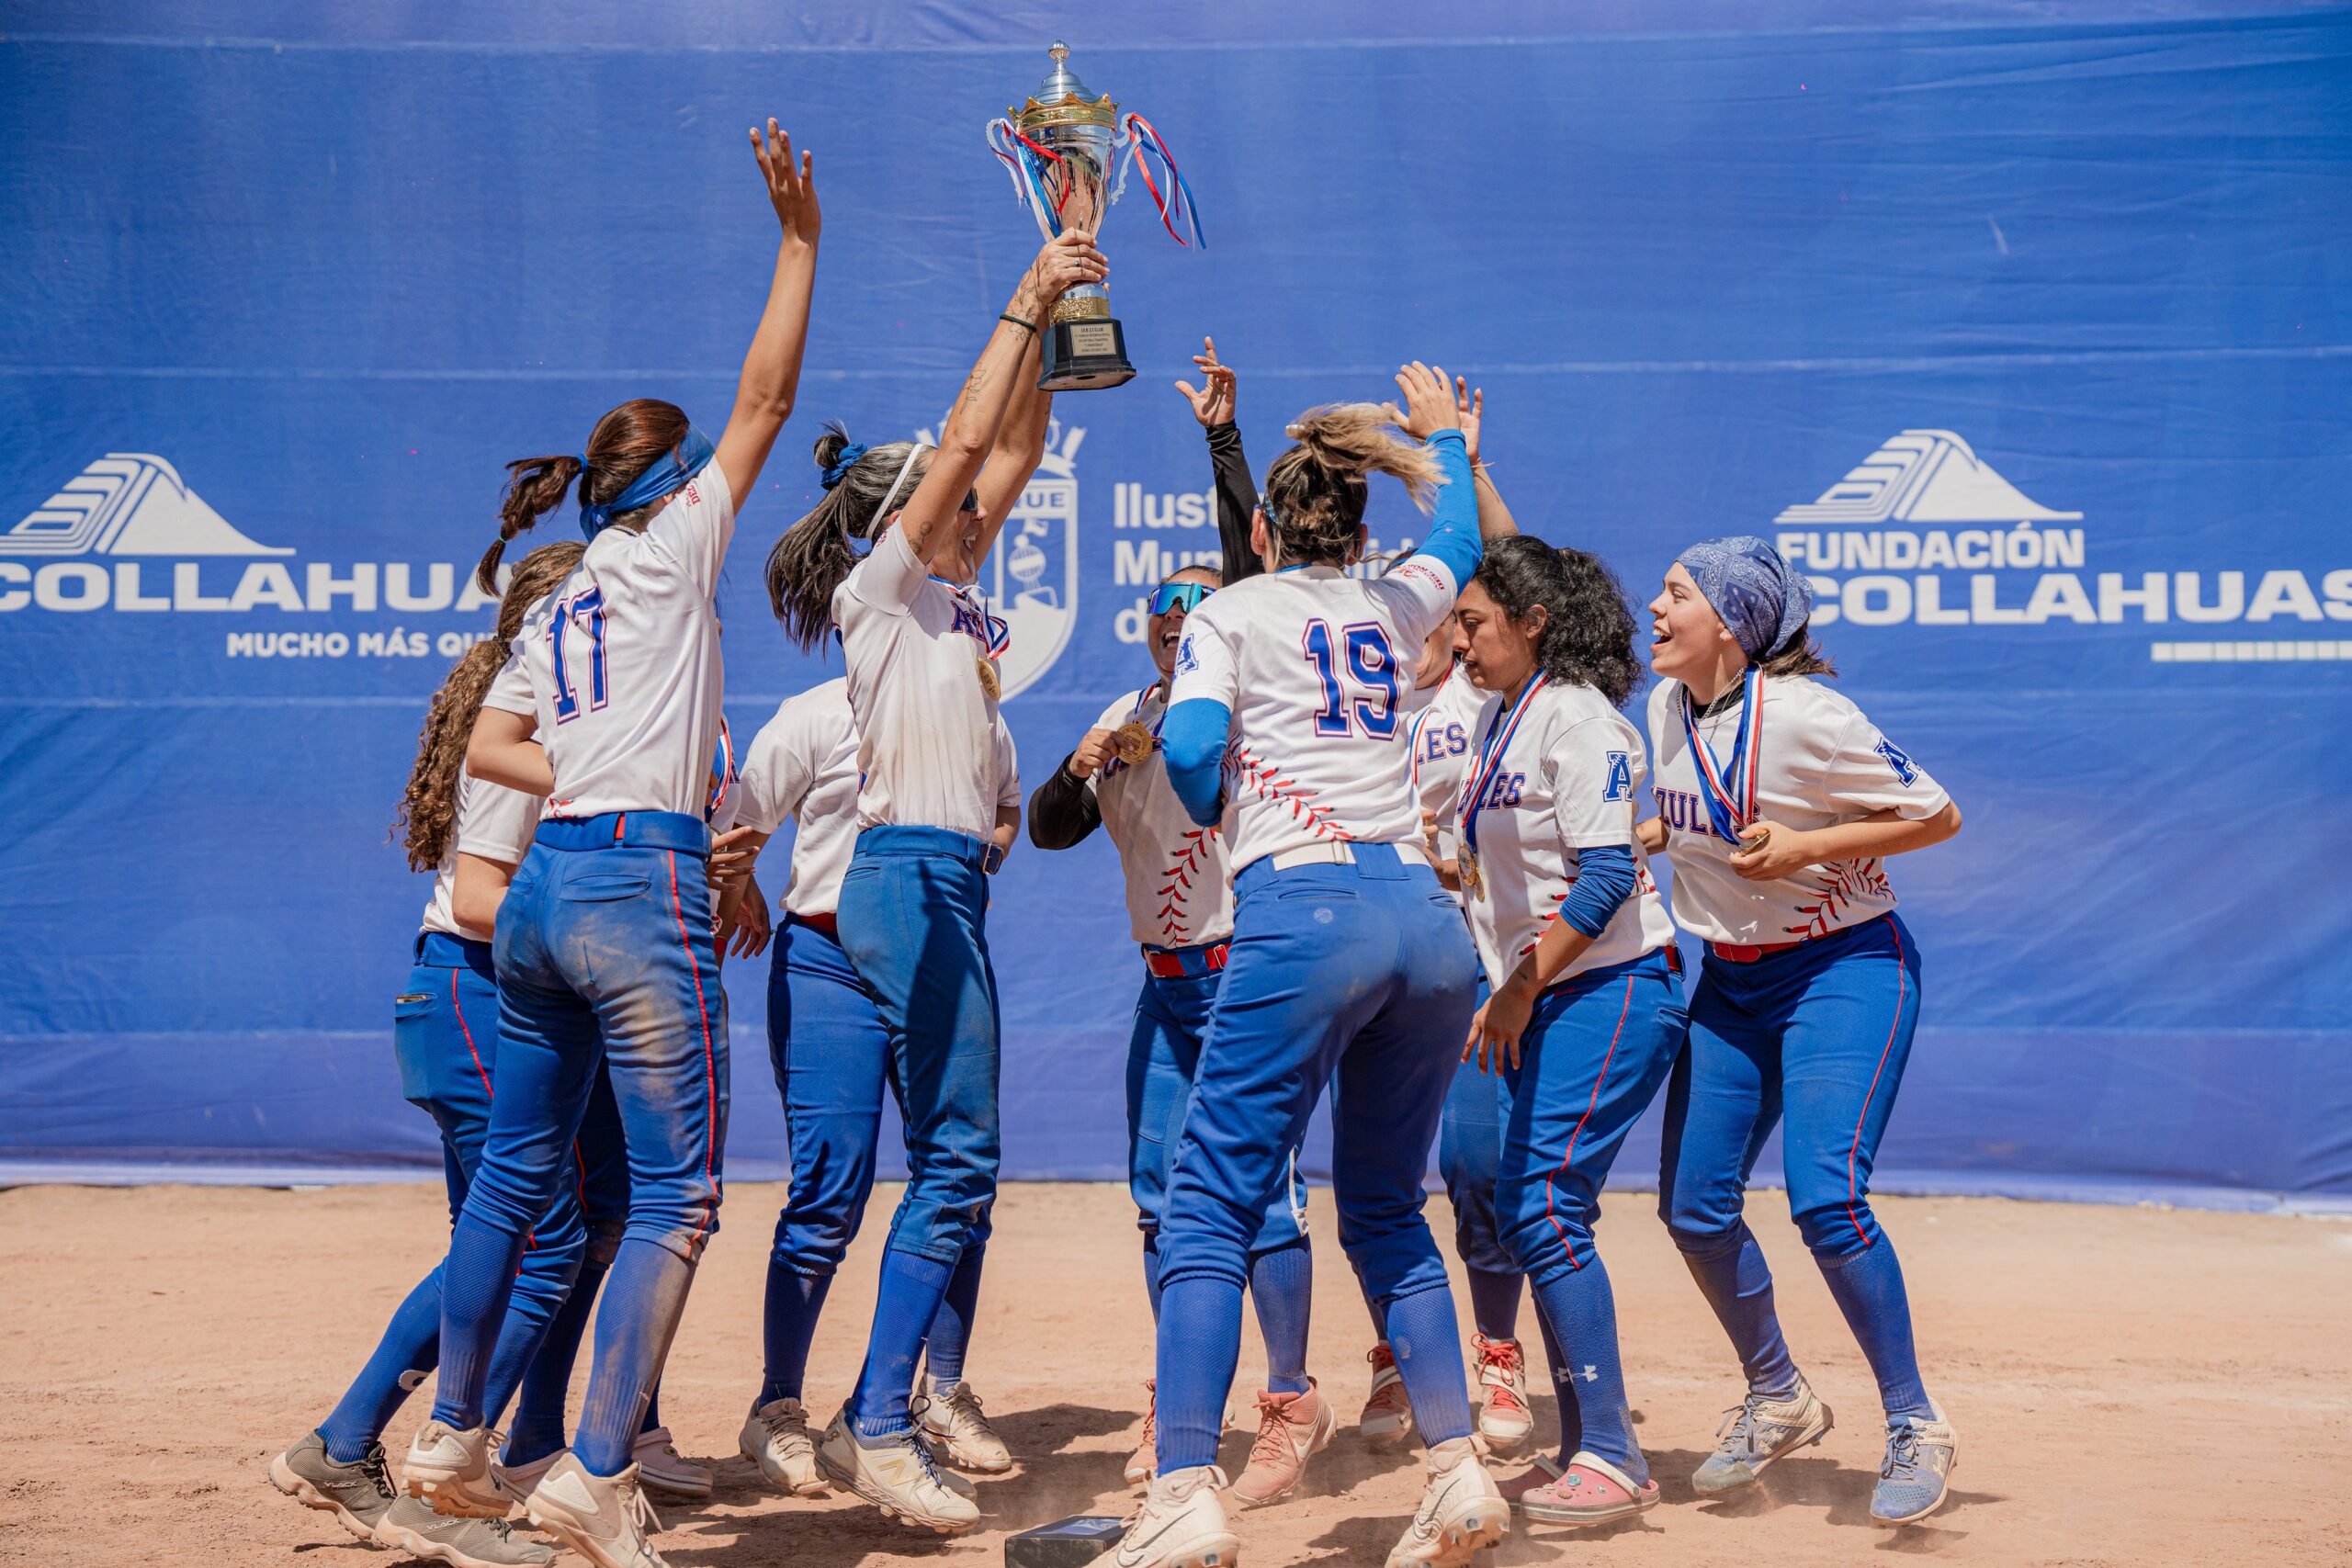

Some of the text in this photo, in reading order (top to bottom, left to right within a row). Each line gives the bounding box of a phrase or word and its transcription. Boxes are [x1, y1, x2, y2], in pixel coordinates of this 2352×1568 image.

[1114, 482, 1220, 528] Ilust
[1776, 521, 2085, 570] FUNDACIÓN
[0, 561, 514, 612] OLLAHUA
[226, 632, 350, 658] MUCHO
[357, 626, 430, 658] MÁS
[546, 583, 607, 726] 17
[1302, 616, 1401, 740] 19
[1602, 750, 1634, 802] A
[426, 1518, 460, 1530] VLACK
